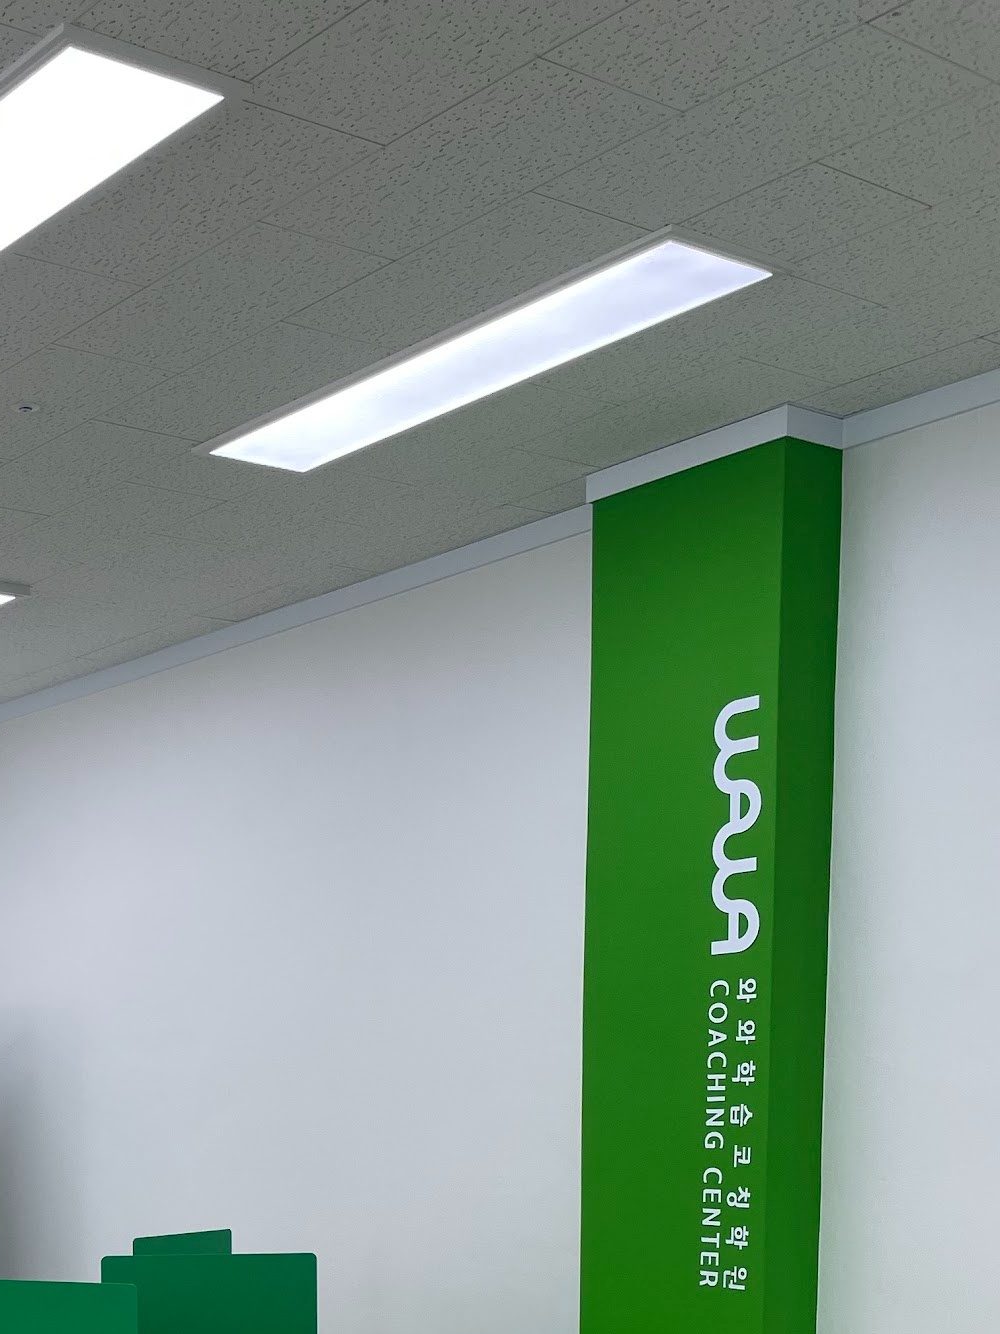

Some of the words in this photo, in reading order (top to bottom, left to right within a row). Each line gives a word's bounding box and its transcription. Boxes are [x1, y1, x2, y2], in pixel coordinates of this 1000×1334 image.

[704, 979, 730, 1149] COACHING
[723, 978, 757, 1291] 와와학습코칭학원
[700, 1167, 723, 1287] CENTER
